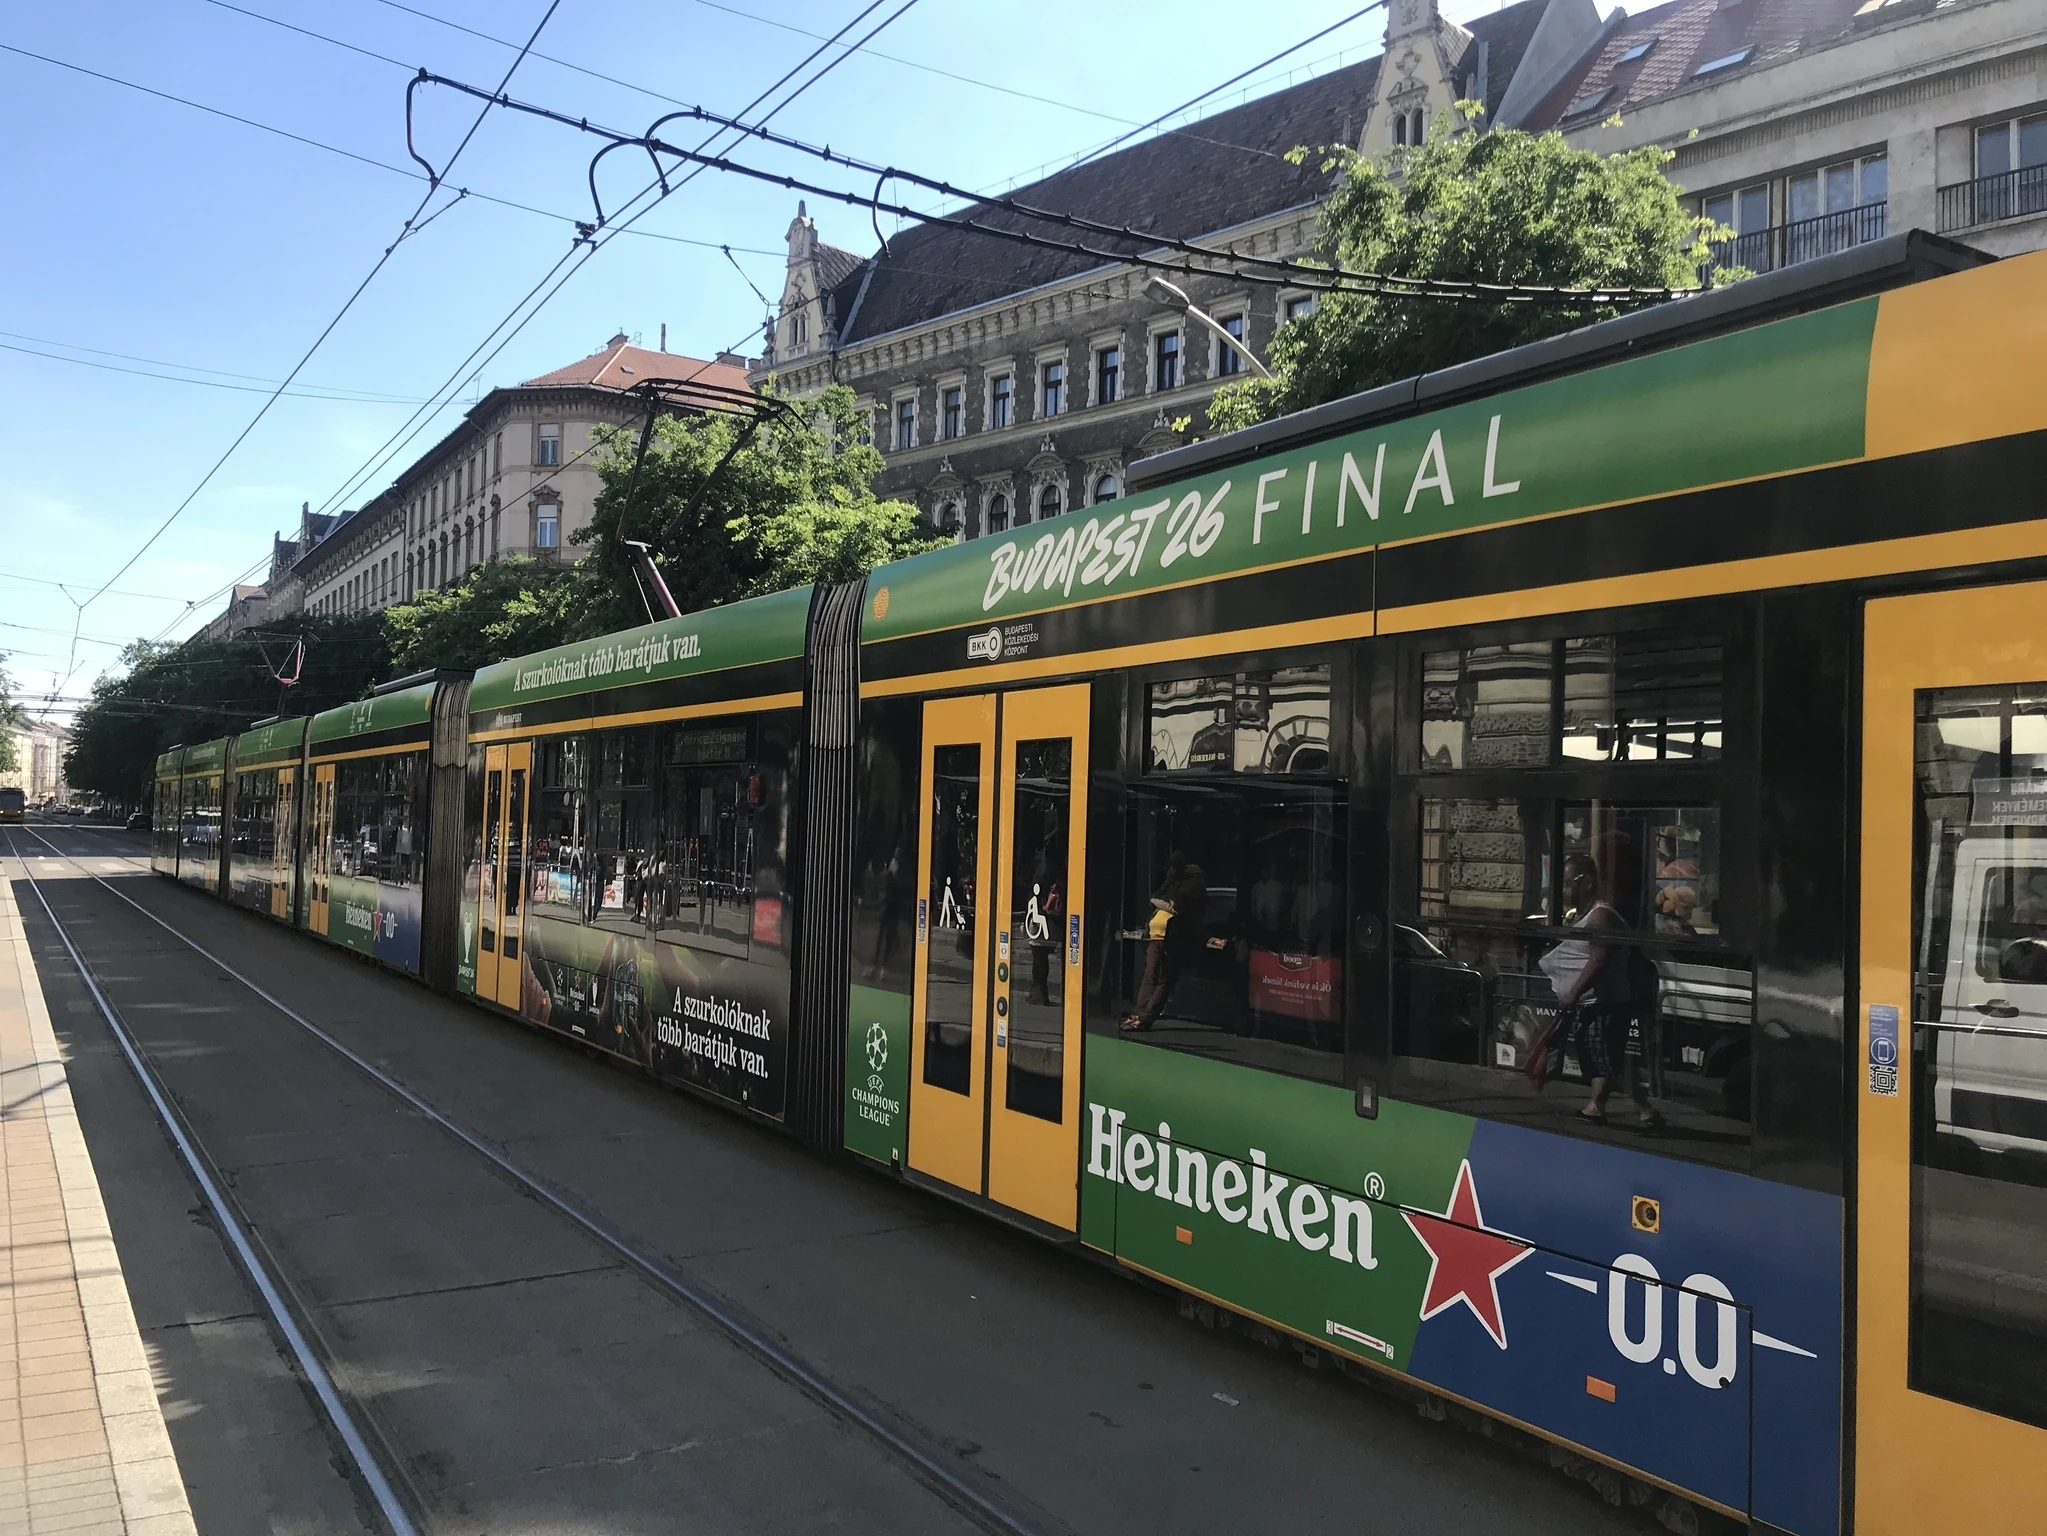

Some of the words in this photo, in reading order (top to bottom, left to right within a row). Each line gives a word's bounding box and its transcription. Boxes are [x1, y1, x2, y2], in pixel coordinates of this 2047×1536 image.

[982, 497, 1171, 612] BUDAPEST
[1159, 479, 1232, 568] 26
[1252, 414, 1521, 545] FINAL
[1004, 623, 1033, 636] BUDAPESTI
[1004, 632, 1039, 646] KÖZLEKEDÉSI
[971, 640, 987, 652] BKK
[1004, 645, 1029, 657] KÖZPONT
[513, 668, 521, 692] A
[522, 653, 587, 690] szurkolóknak
[588, 647, 614, 676] több
[615, 633, 670, 674] barátjuk
[673, 634, 701, 661] van.
[672, 987, 682, 1014] A
[684, 995, 771, 1041] szurkolóknak
[657, 1016, 682, 1048] több
[684, 1023, 738, 1069] barátjuk
[739, 1048, 769, 1079] van.
[867, 1076, 883, 1092] UEFA
[852, 1087, 900, 1114] CHAMPIONS
[859, 1104, 891, 1127] LEAGUE
[1087, 1102, 1379, 1270] Heineken
[1608, 1253, 1737, 1389] 0.0
